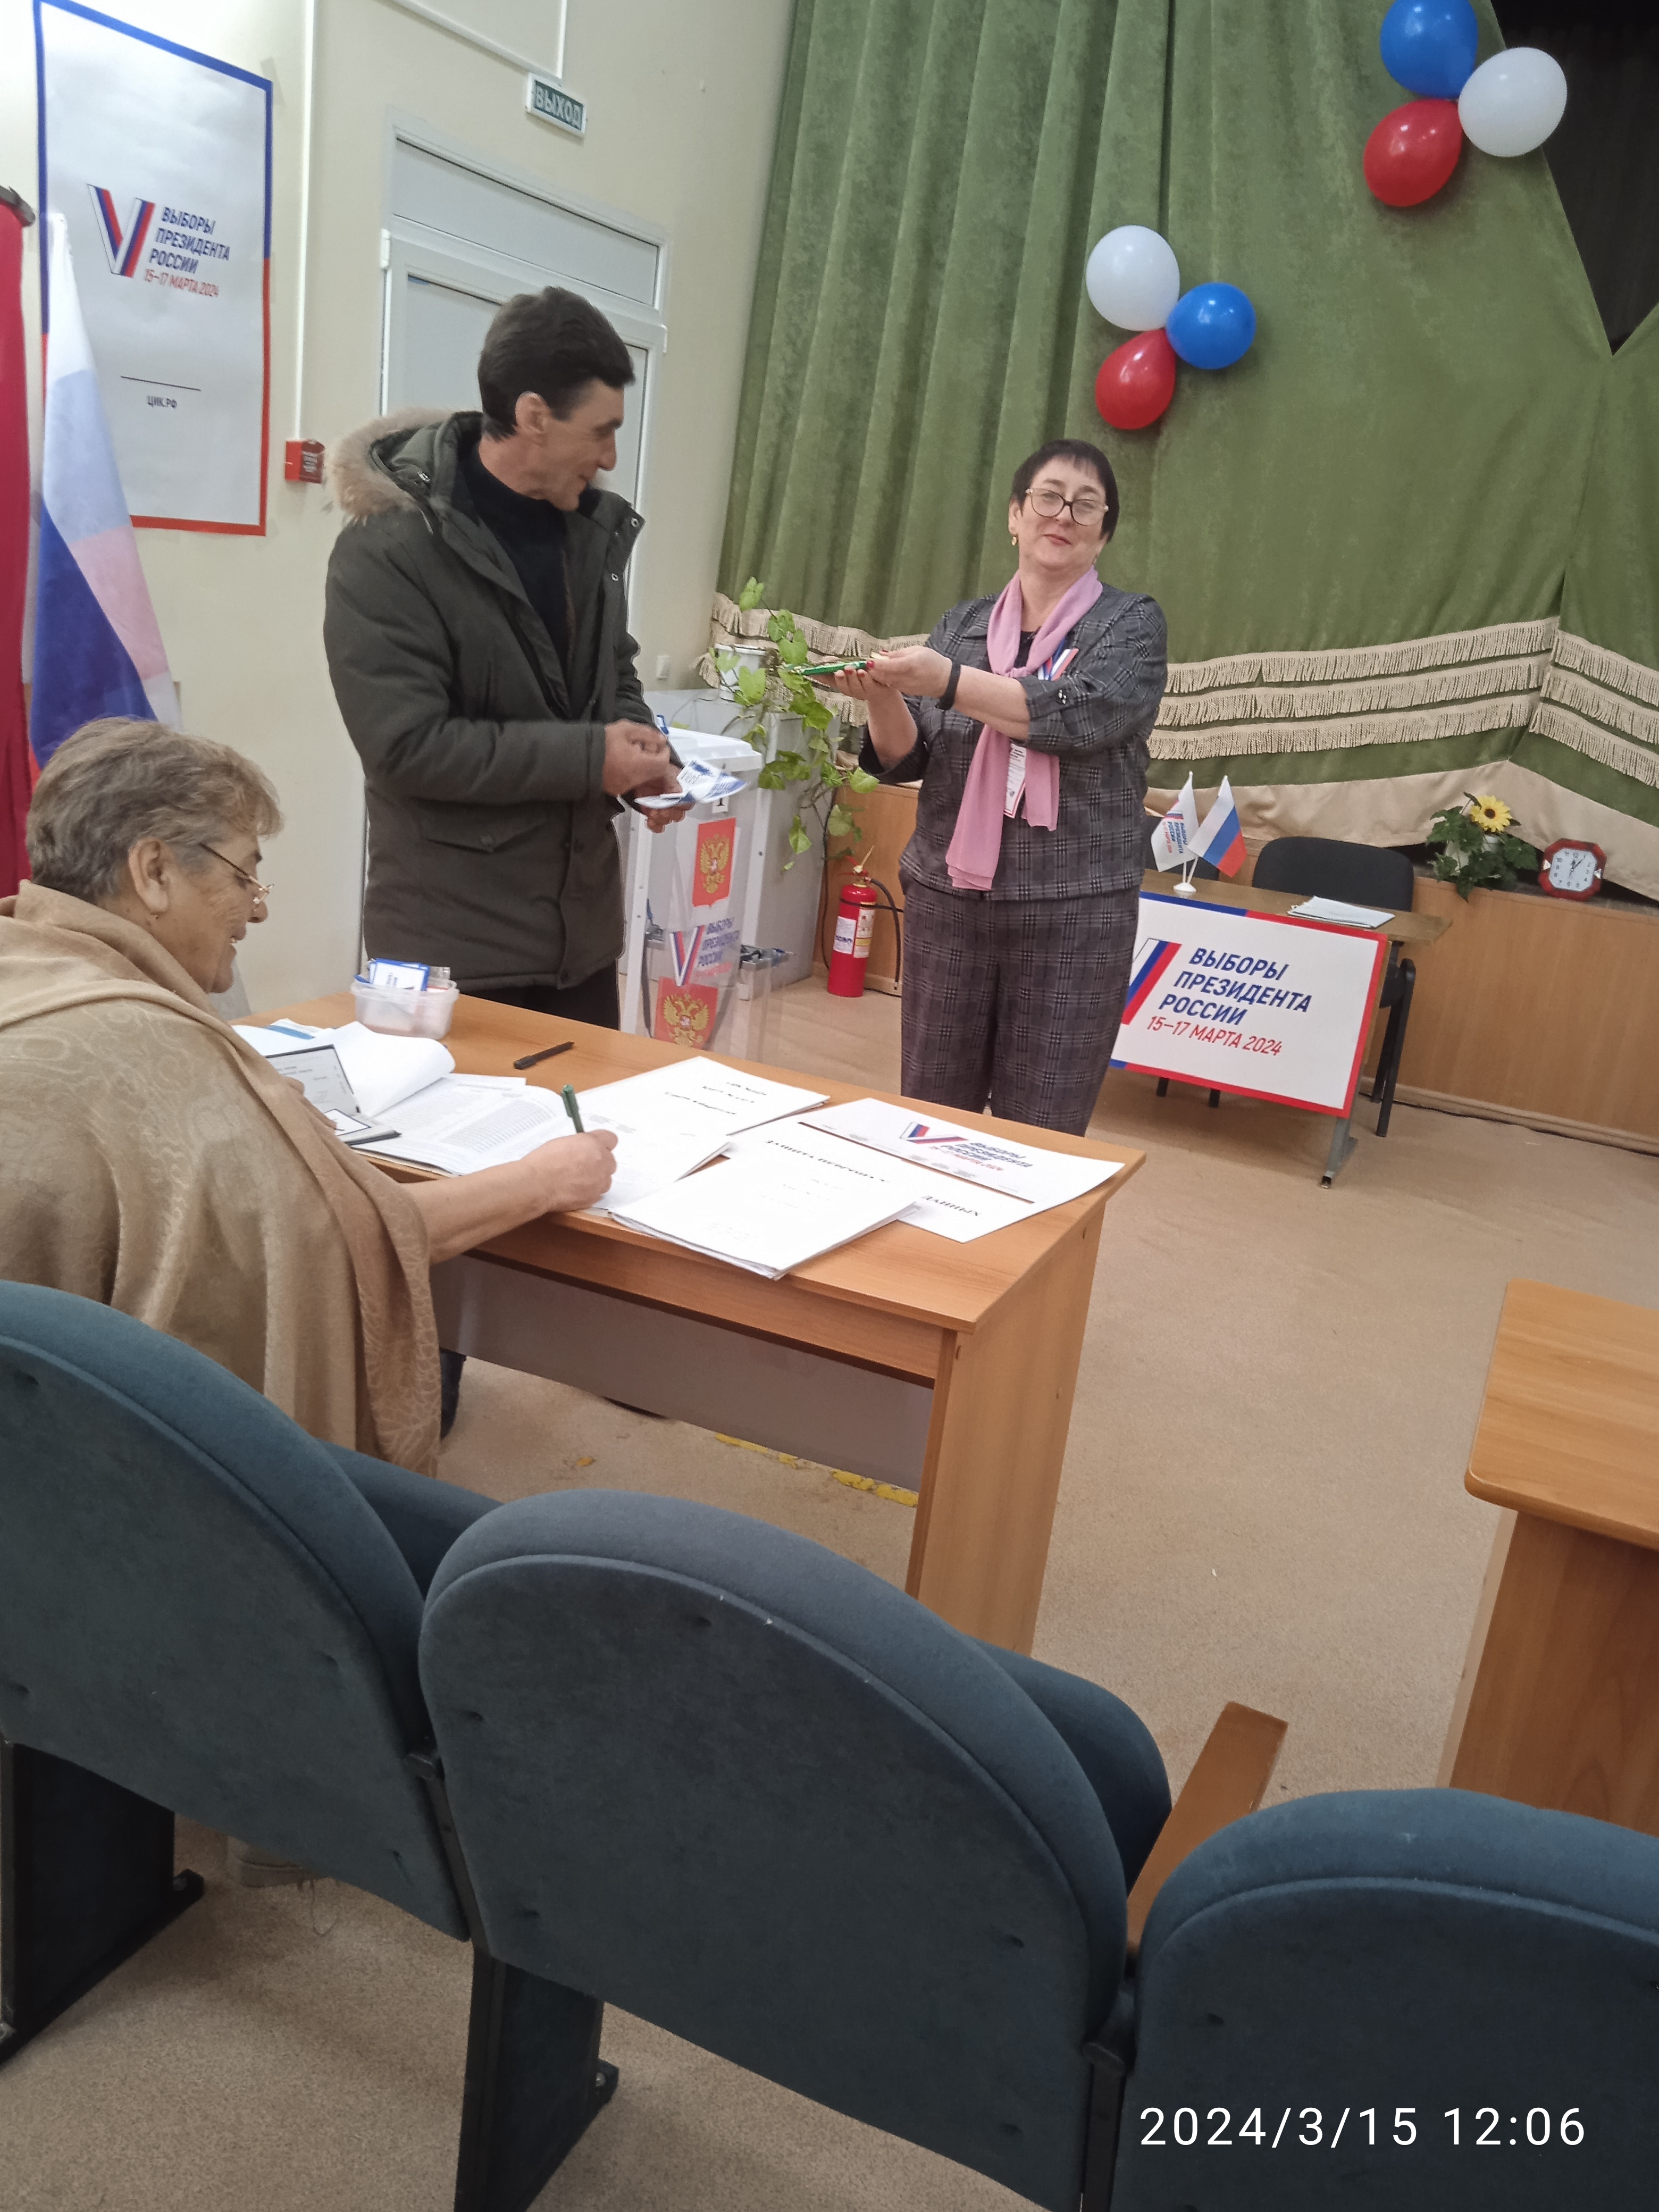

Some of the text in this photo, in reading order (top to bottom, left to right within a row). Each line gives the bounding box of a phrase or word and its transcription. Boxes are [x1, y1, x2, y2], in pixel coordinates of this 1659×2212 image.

[536, 85, 580, 129] ВЫХОД
[161, 206, 216, 234] ВЫБОРЫ
[155, 228, 230, 261] ПРЕЗИДЕНТА
[149, 248, 199, 274] РОССИИ
[170, 275, 198, 293] МАРТА
[199, 282, 219, 297] 2024
[147, 396, 177, 409] ЦИК.РФ
[1189, 948, 1289, 981] ВЫБОРЫ
[1174, 970, 1312, 1012] ПРЕЗИДЕНТА
[1158, 993, 1248, 1026] РОССИИ
[1189, 1024, 1243, 1048] МАРТА
[1242, 1036, 1283, 1056] 2024
